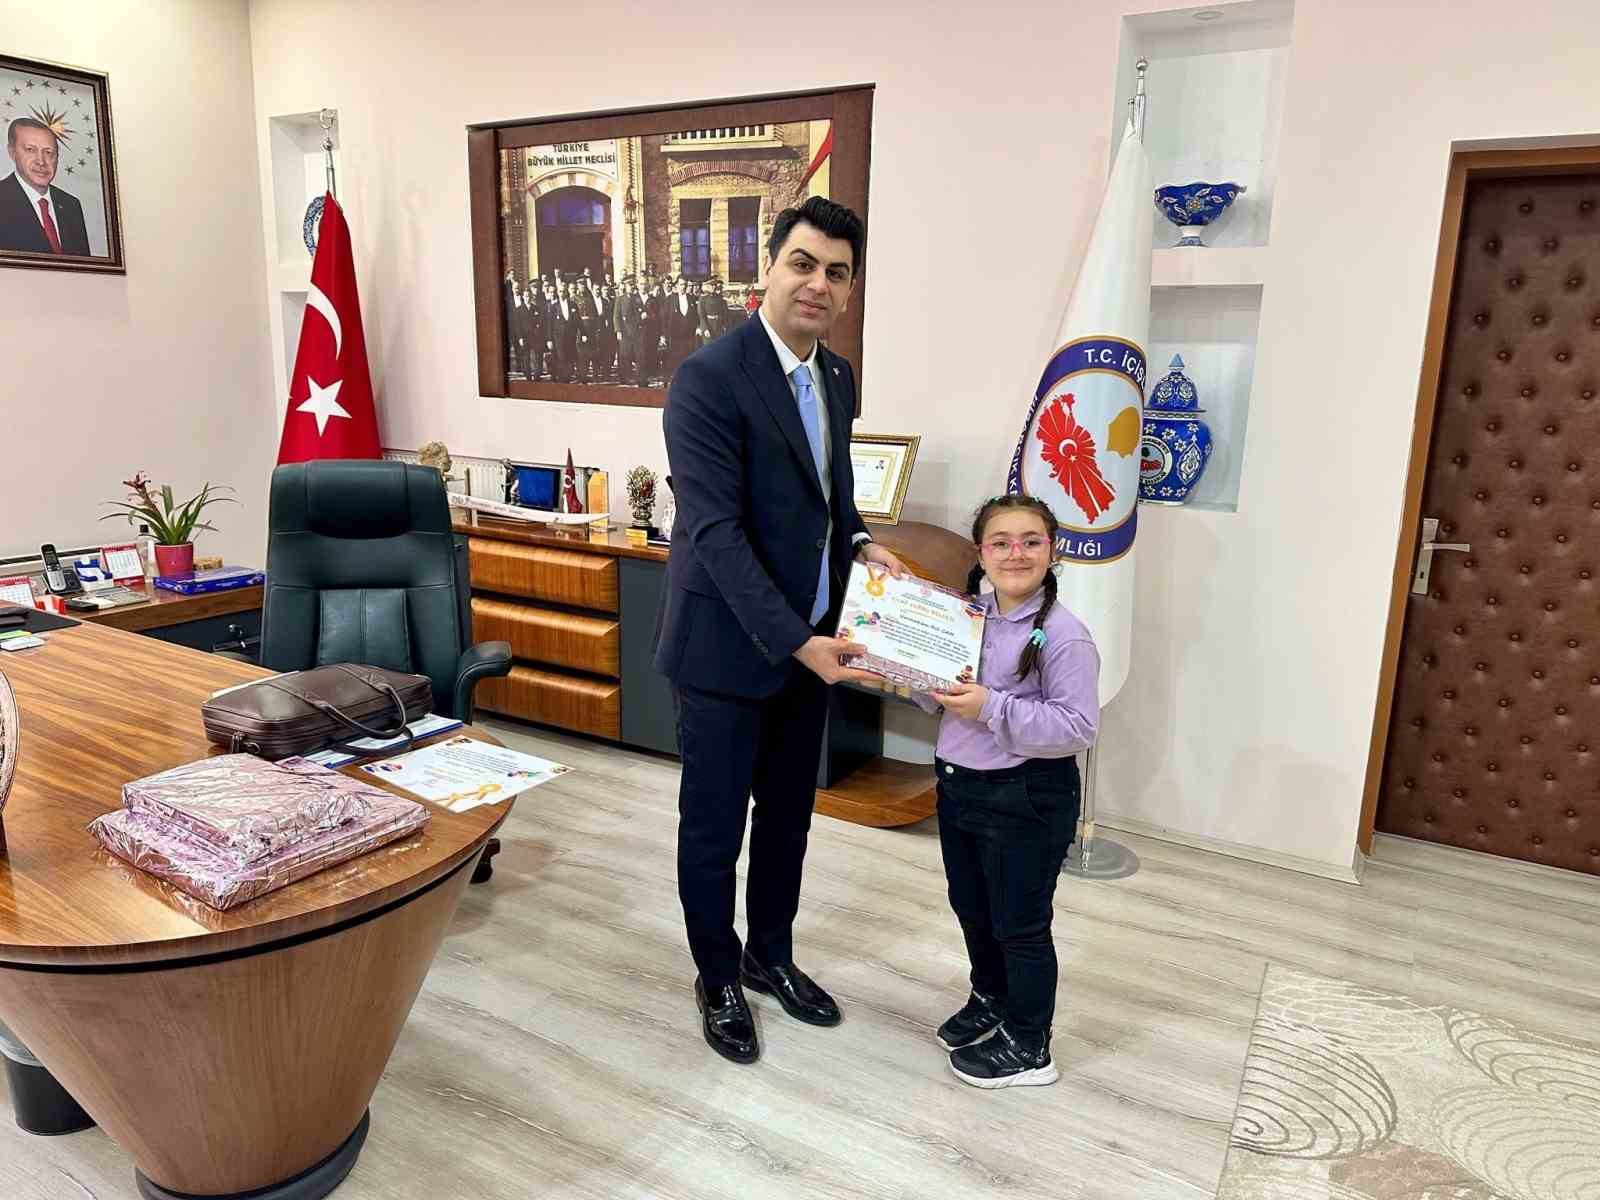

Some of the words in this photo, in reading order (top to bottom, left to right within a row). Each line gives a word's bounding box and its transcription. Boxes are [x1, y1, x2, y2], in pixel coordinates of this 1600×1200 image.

[527, 154, 556, 167] BÜYÜK
[557, 154, 583, 166] MİLLET
[1084, 348, 1117, 364] T.C.
